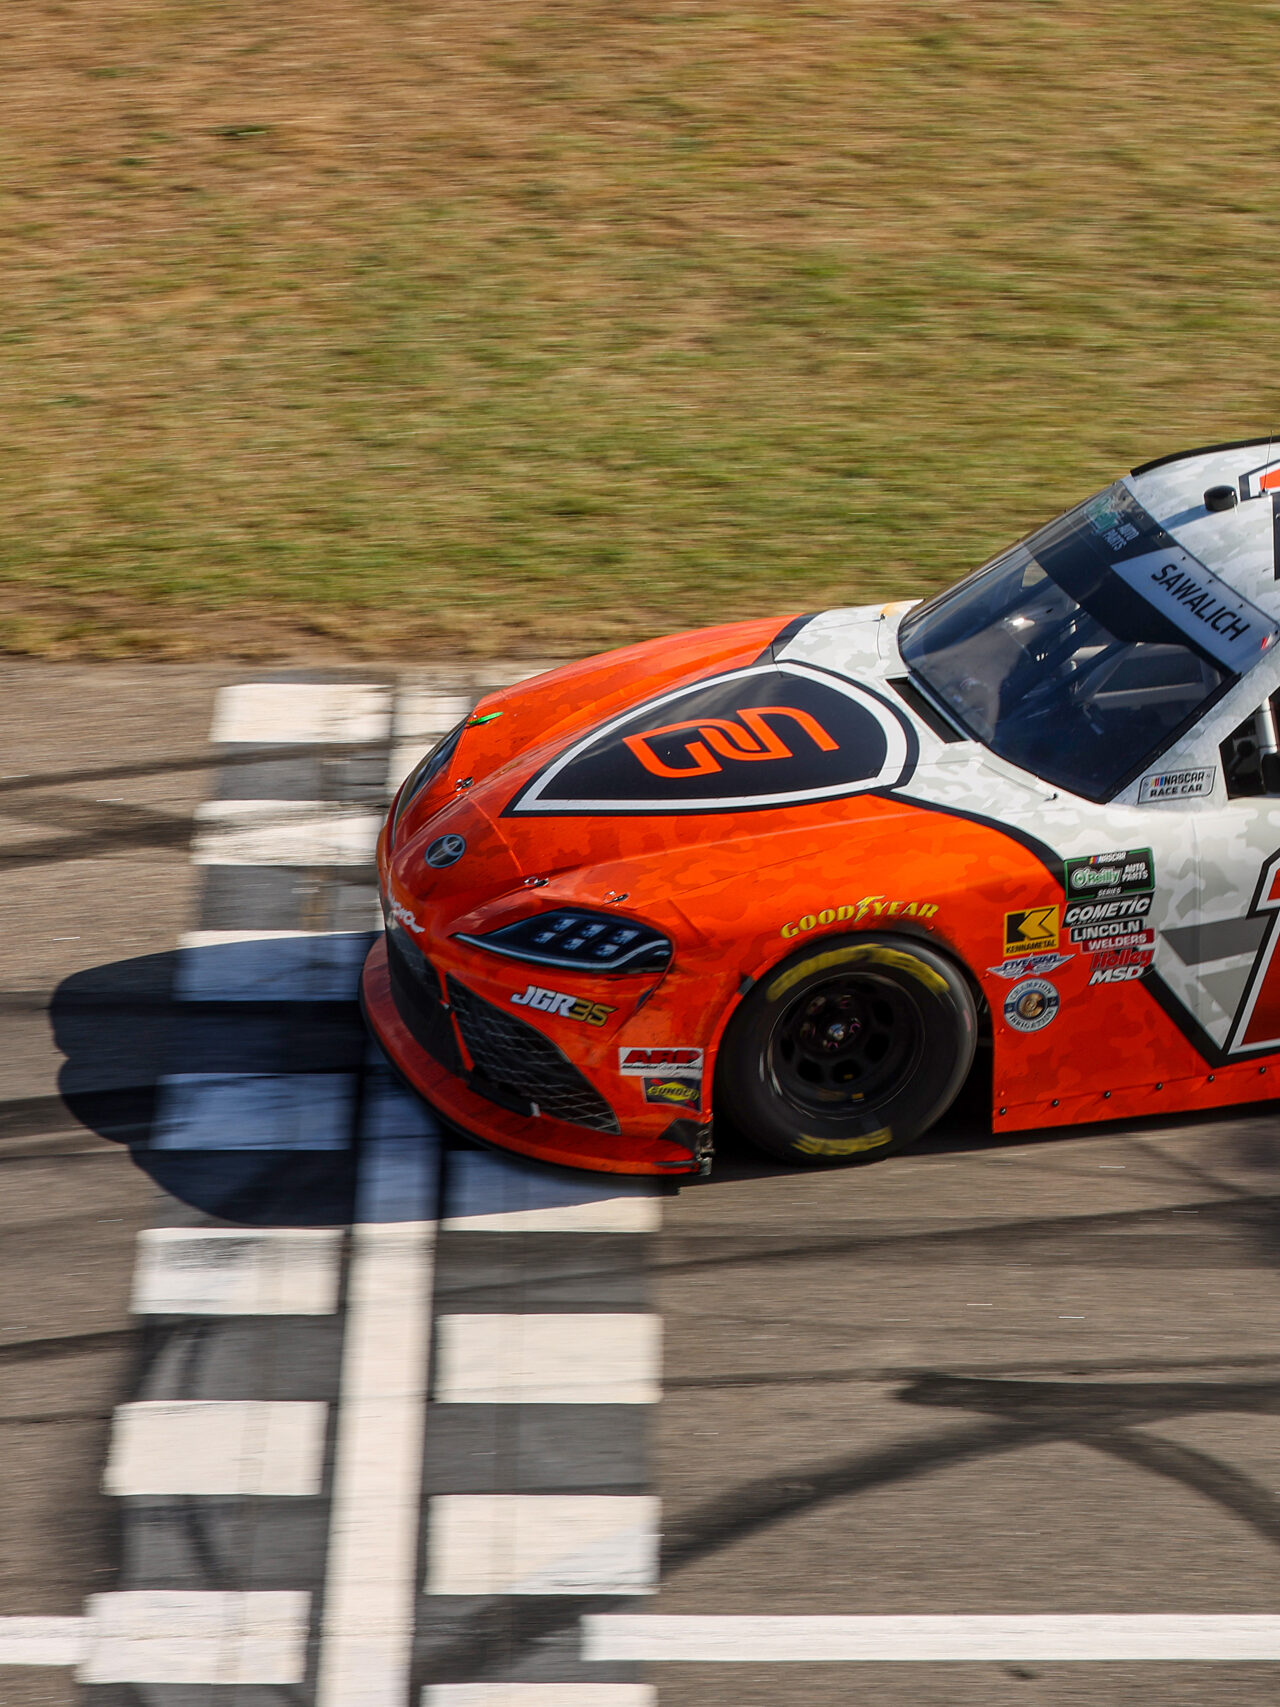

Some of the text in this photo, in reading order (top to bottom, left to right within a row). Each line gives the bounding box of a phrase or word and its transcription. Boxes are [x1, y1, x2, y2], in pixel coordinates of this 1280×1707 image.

[1150, 563, 1251, 642] SAWALICH
[1164, 771, 1206, 786] NASCAR
[1150, 784, 1203, 798] RACE CAR
[1099, 851, 1127, 862] NASCAR
[1125, 862, 1146, 873] AUTO
[1073, 867, 1122, 889] O'Reilly
[1122, 870, 1149, 882] PARTS
[1098, 887, 1121, 896] SERIES
[780, 896, 939, 939] GOODYEAR
[1066, 896, 1150, 923] COMETIC
[1073, 920, 1141, 942] LINCOLN
[1088, 933, 1148, 951] WELDERS
[1091, 947, 1155, 972] Holley
[1088, 966, 1145, 986] MSD
[624, 1050, 701, 1064] ARP
[648, 1086, 700, 1101] SUNOCO
